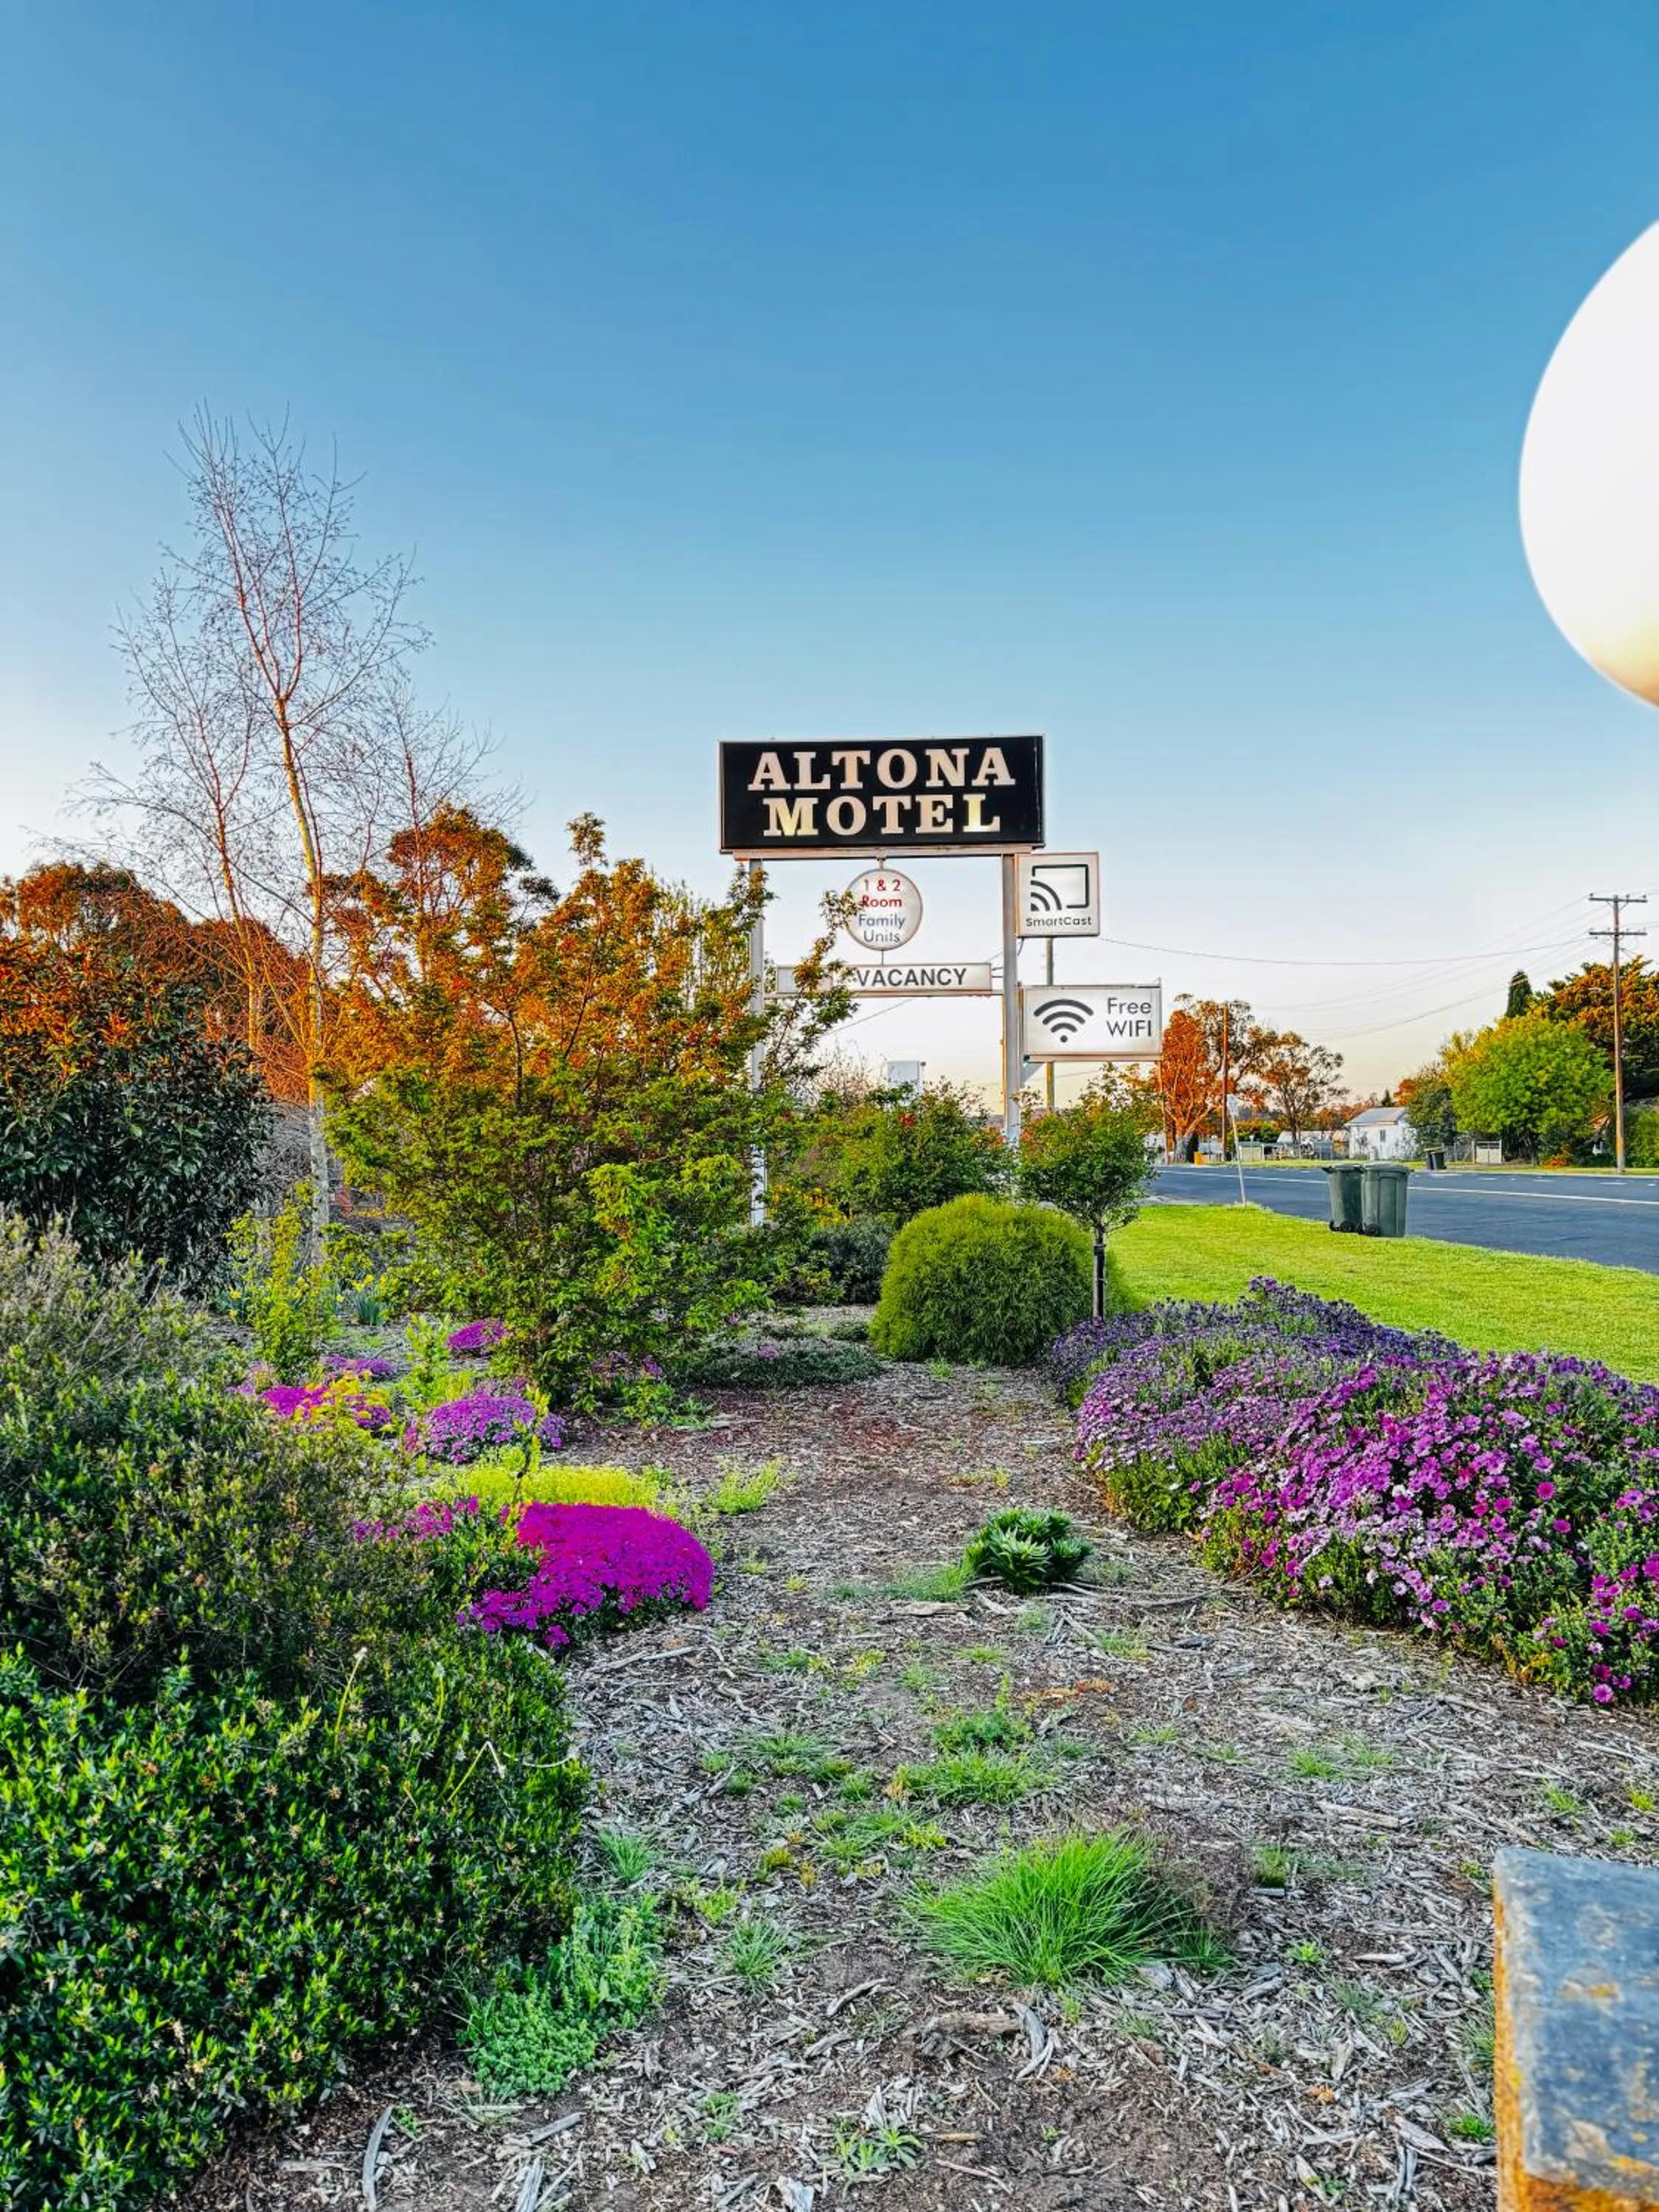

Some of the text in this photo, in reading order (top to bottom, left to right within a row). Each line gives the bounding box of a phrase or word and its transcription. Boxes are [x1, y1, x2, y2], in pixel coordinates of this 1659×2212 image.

[748, 747, 1016, 790] ALTONA
[762, 793, 1001, 837] MOTEL
[863, 879, 901, 891] 1 & 2
[861, 895, 902, 908] Room
[858, 914, 905, 929] Family
[1026, 917, 1092, 927] SmartCast
[863, 930, 900, 943] Units
[857, 967, 967, 987] VACANCY
[1107, 997, 1152, 1015] Free
[1107, 1020, 1152, 1037] WIFI
